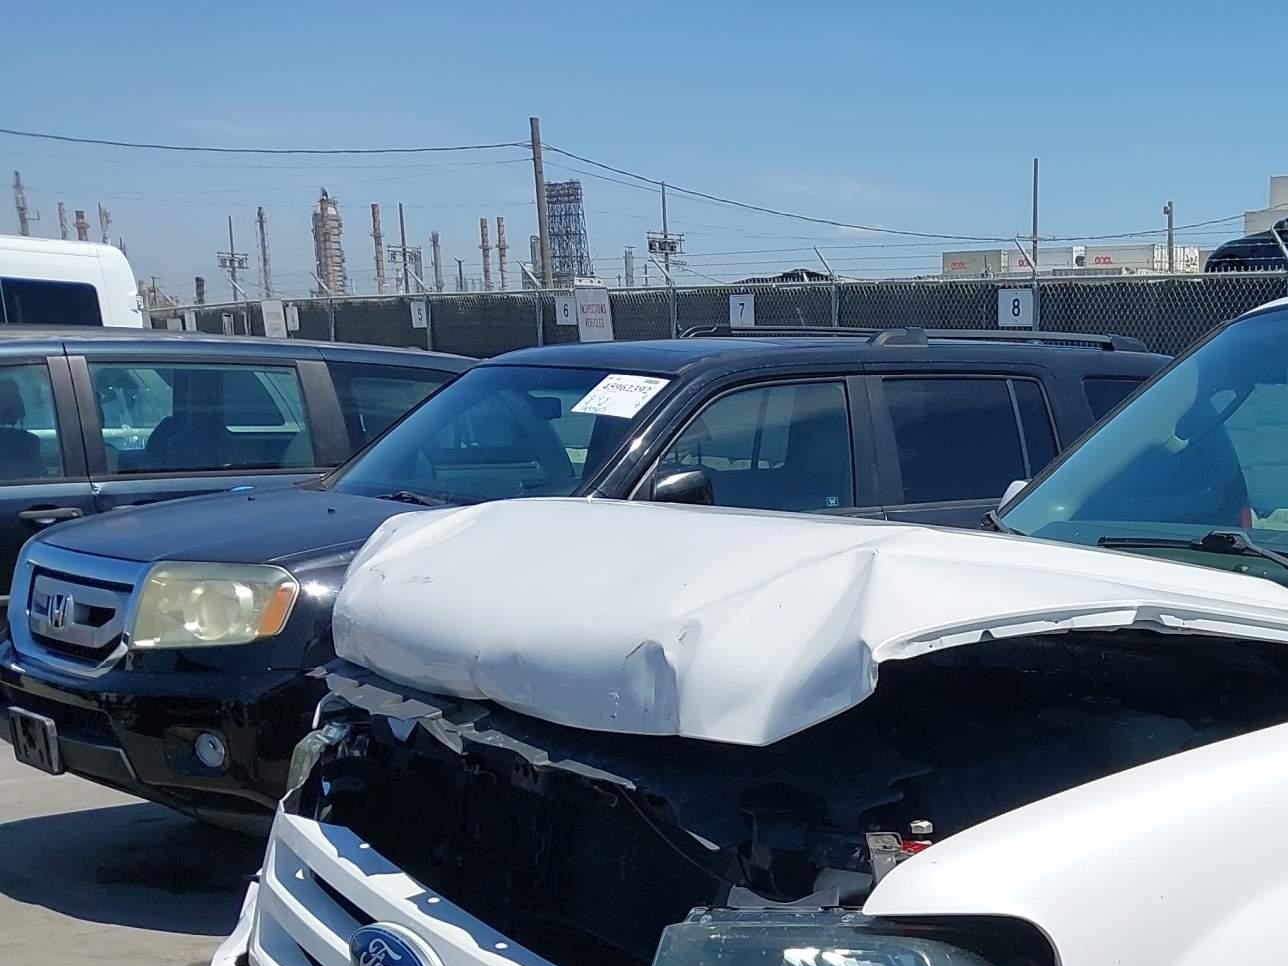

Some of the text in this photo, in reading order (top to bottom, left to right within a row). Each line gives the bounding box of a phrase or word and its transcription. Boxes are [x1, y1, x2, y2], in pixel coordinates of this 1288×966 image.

[417, 308, 423, 321] 5
[563, 303, 569, 318] 6
[738, 302, 745, 319] 7
[1012, 298, 1021, 317] 8
